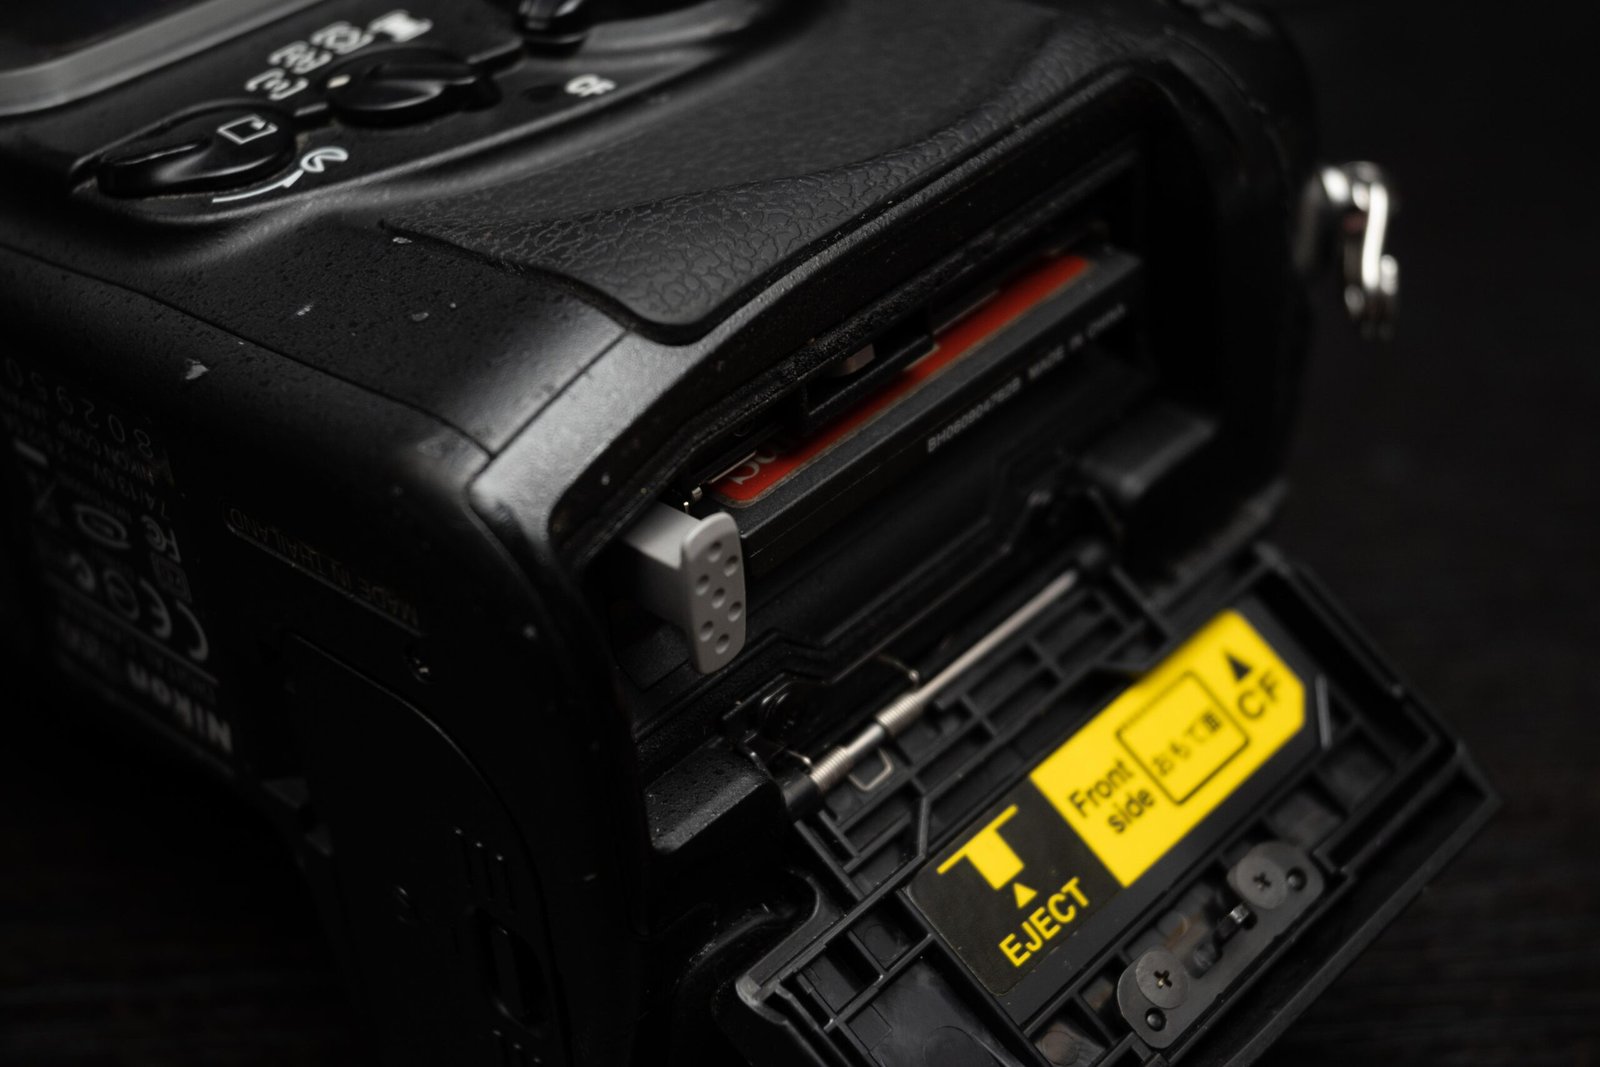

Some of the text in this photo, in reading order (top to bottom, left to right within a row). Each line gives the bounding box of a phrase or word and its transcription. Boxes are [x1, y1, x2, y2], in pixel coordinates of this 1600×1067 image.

[127, 660, 233, 754] Nikon
[1236, 669, 1282, 721] CF
[1067, 757, 1135, 819] Front
[1107, 784, 1156, 835] side
[998, 875, 1091, 968] EJECT
